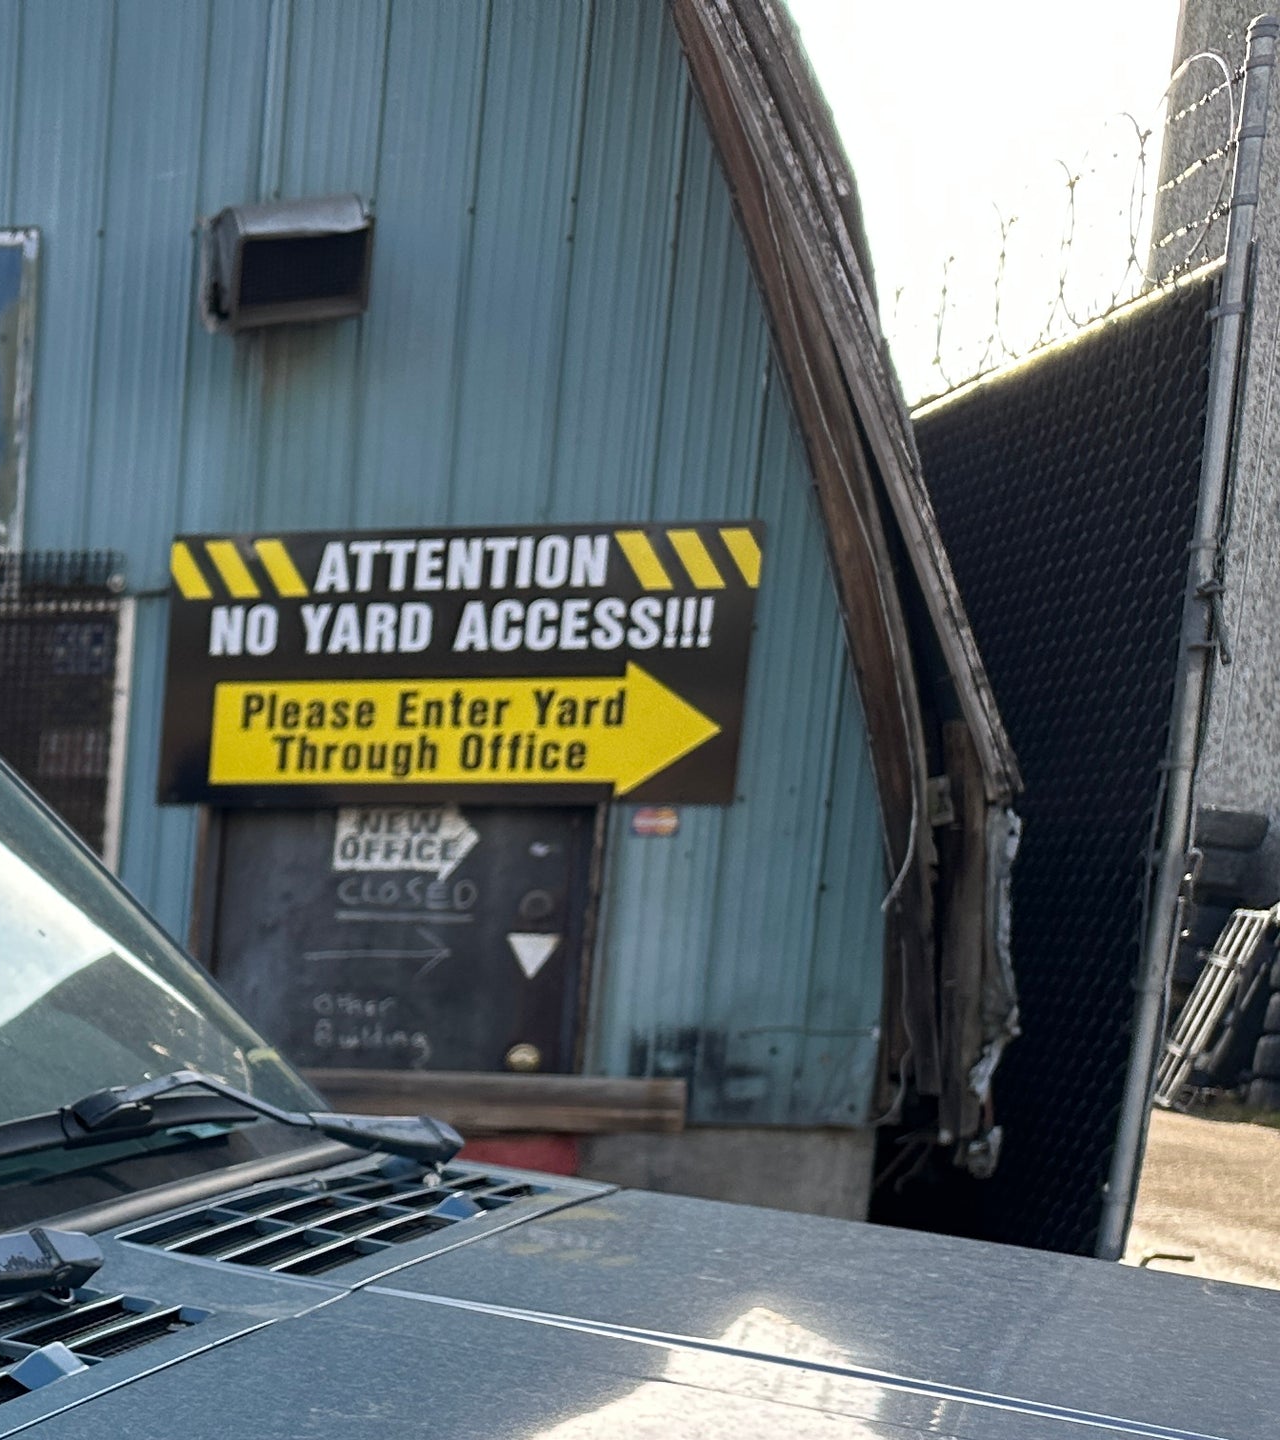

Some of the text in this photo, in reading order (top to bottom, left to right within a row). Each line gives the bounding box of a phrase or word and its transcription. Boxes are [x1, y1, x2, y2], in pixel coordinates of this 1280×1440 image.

[313, 534, 609, 594] ATTENTION
[209, 596, 715, 656] NO YARD ACCESS!!!
[240, 688, 626, 732] Please Enter Yard
[274, 732, 587, 778] Through Office
[356, 808, 441, 834] NEW
[340, 833, 458, 861] OFFICE
[337, 876, 479, 911] CLOSED
